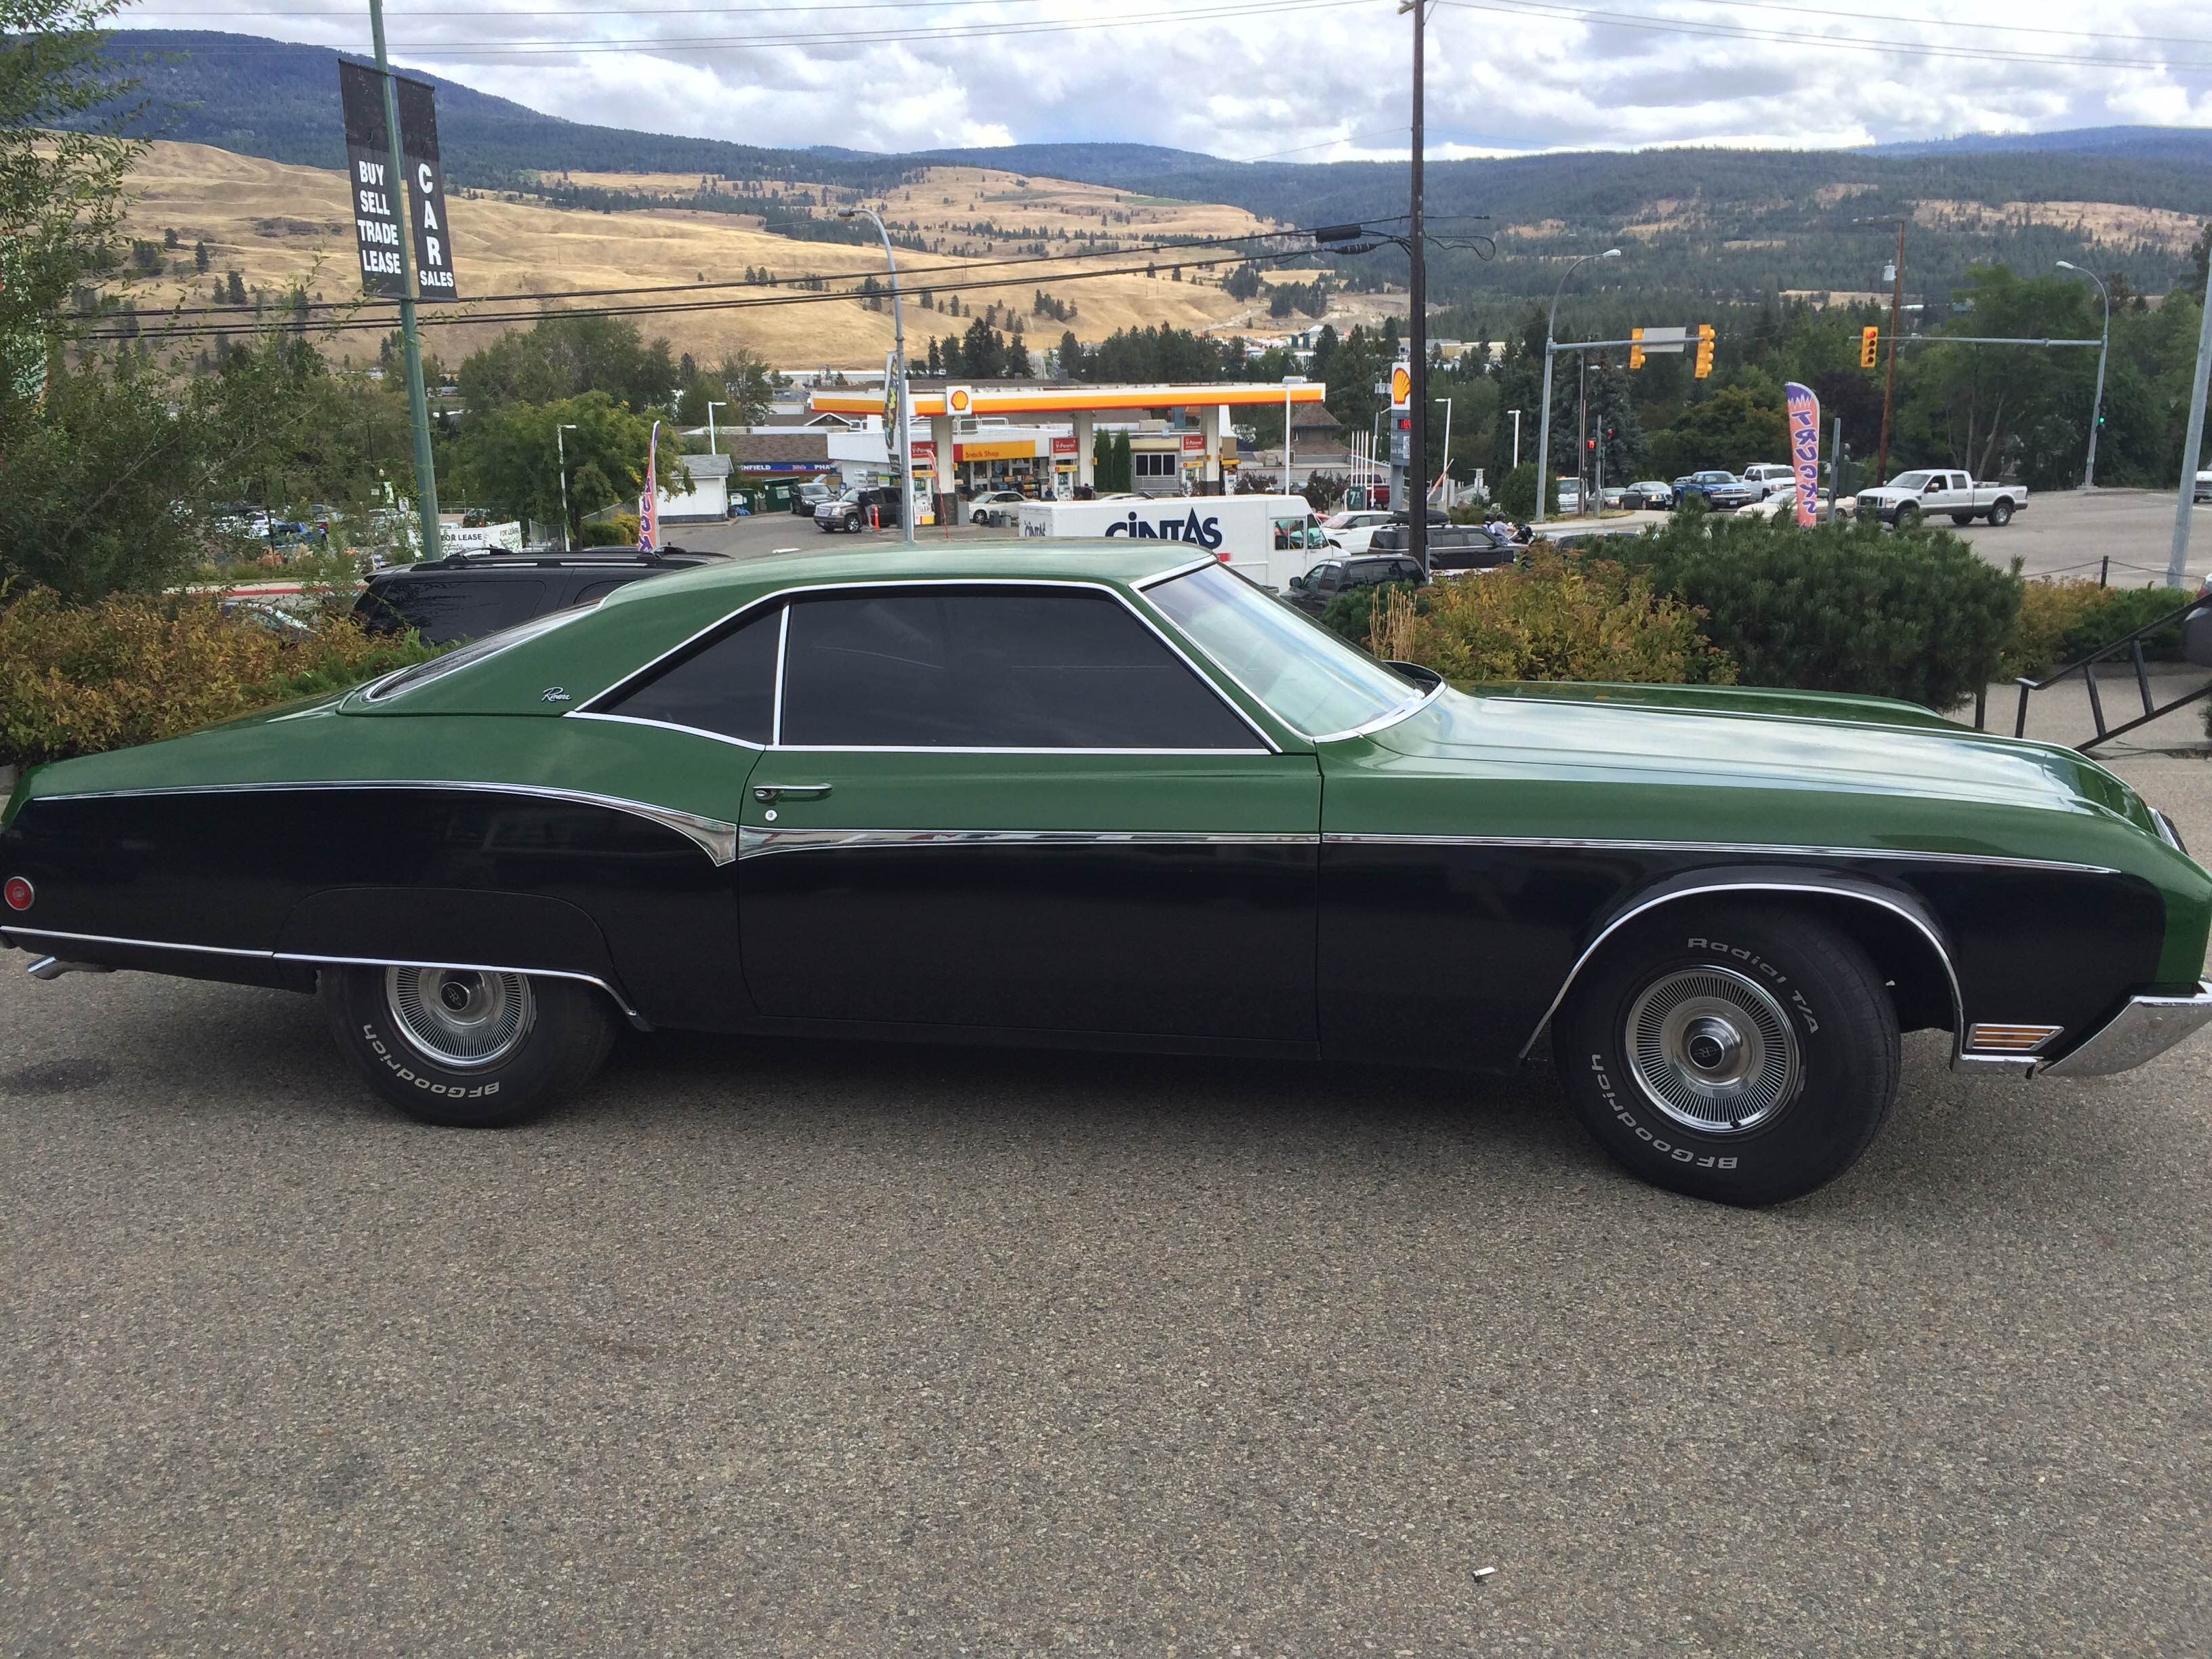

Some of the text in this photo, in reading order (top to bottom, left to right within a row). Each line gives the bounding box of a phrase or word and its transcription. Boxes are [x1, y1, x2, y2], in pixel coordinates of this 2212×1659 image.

[359, 161, 384, 186] BUY
[360, 190, 390, 216] SELL
[418, 163, 442, 265] CAR
[357, 220, 398, 245] TRADE
[363, 249, 401, 274] LEASE
[420, 270, 453, 287] SALES
[1687, 937, 1820, 1033] Radial T/A
[363, 1024, 500, 1099] BFGoodrich
[1591, 1054, 1739, 1170] BFGoodrich
